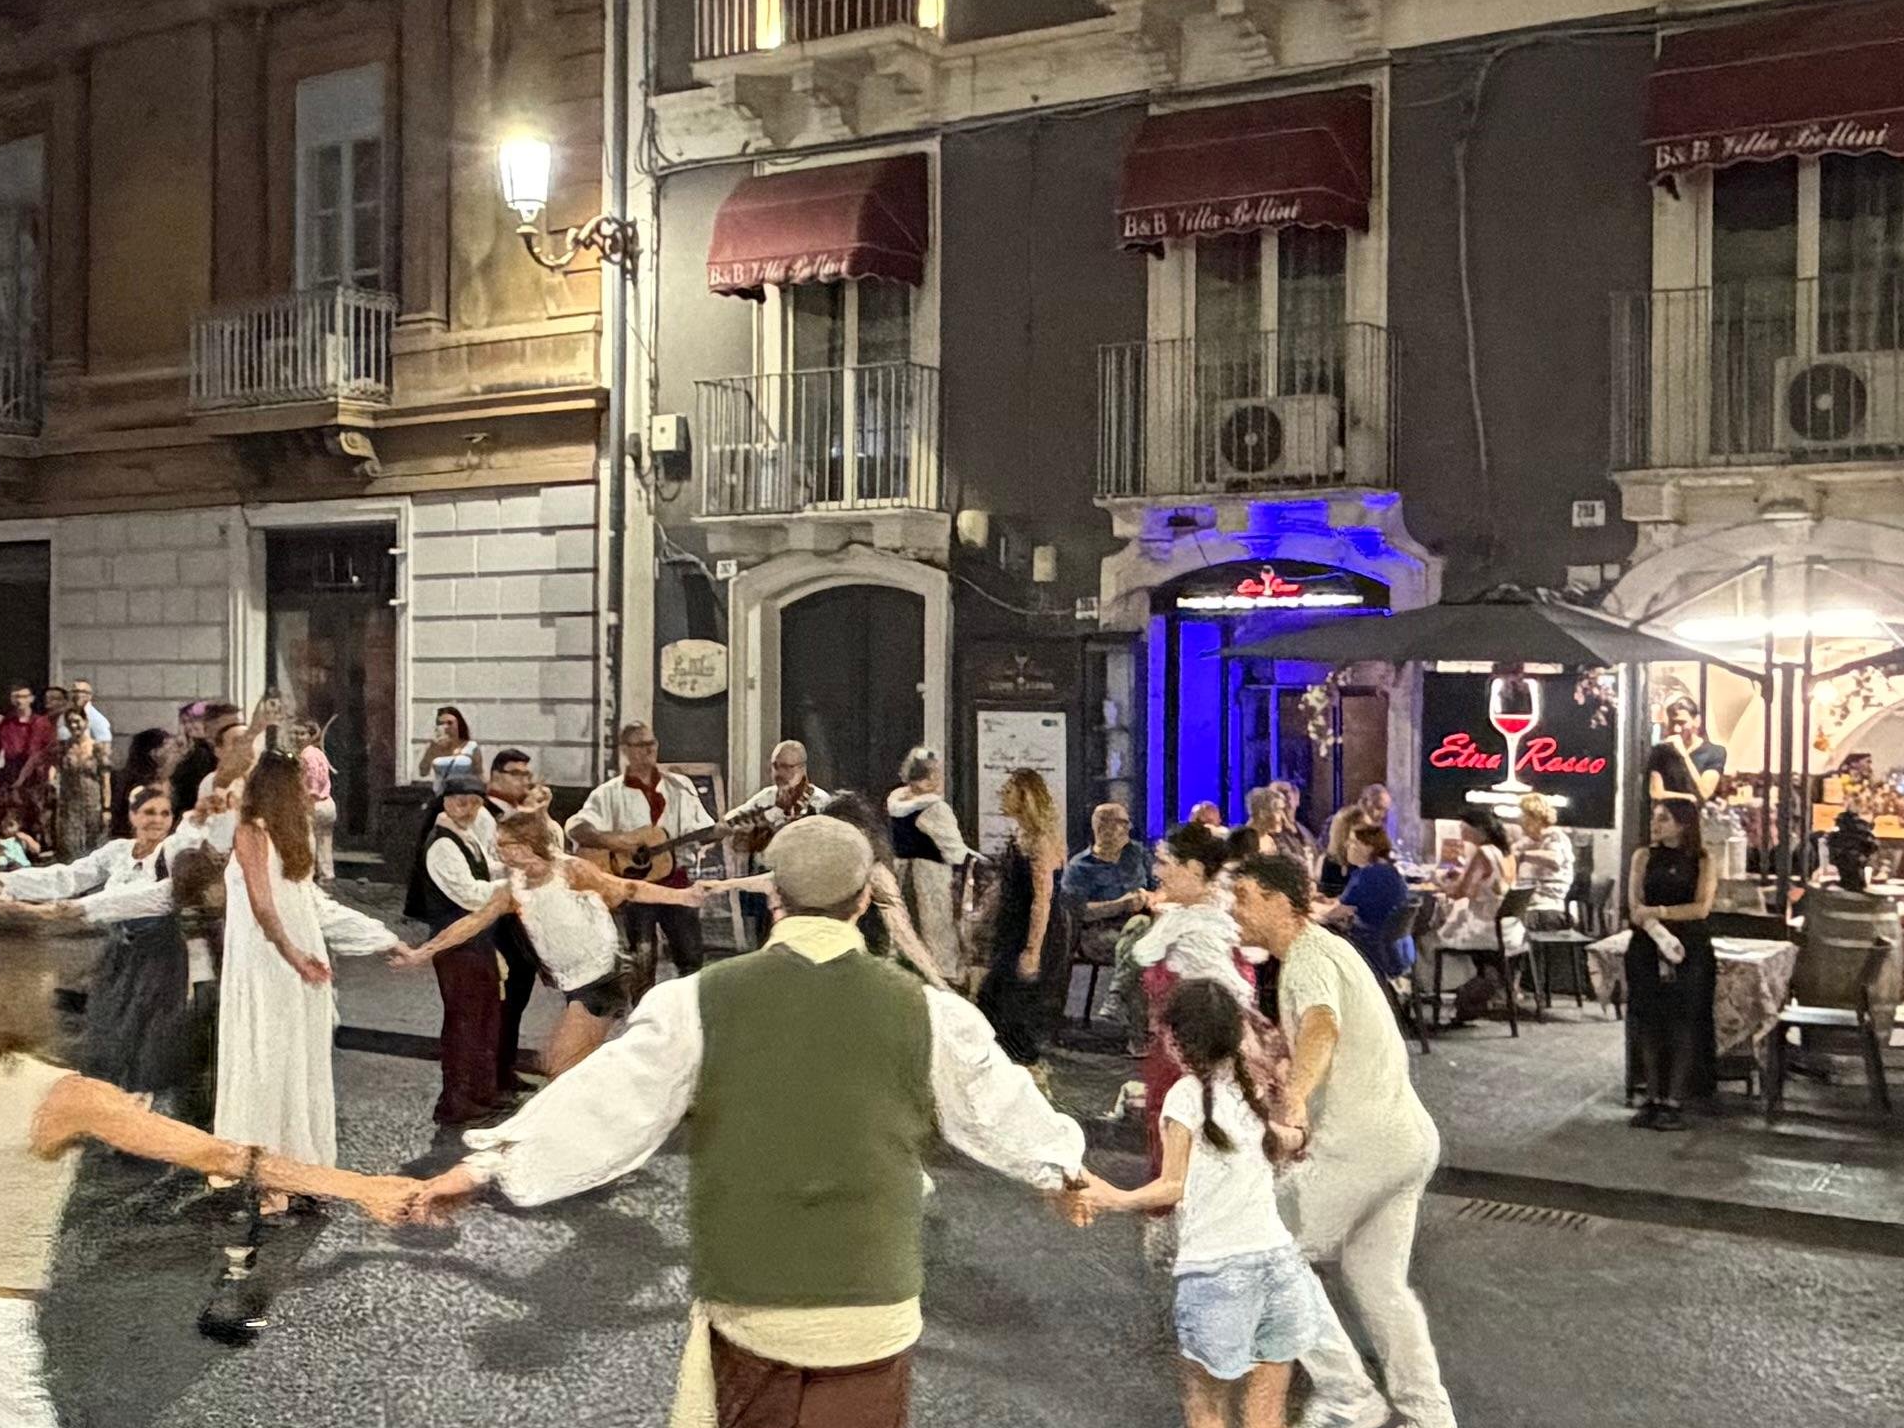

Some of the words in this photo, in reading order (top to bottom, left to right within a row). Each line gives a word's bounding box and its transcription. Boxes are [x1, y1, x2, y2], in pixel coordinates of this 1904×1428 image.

[1655, 140, 1709, 170] B&B
[1722, 131, 1779, 156] Villa
[1785, 121, 1889, 148] Bellini
[1124, 213, 1167, 237] B&B
[1177, 206, 1220, 231] Villa
[1225, 197, 1301, 226] Bellini
[709, 263, 744, 286] B&B
[751, 259, 786, 282] Villa
[1430, 732, 1502, 769] Etna
[1515, 737, 1606, 774] Rosso
